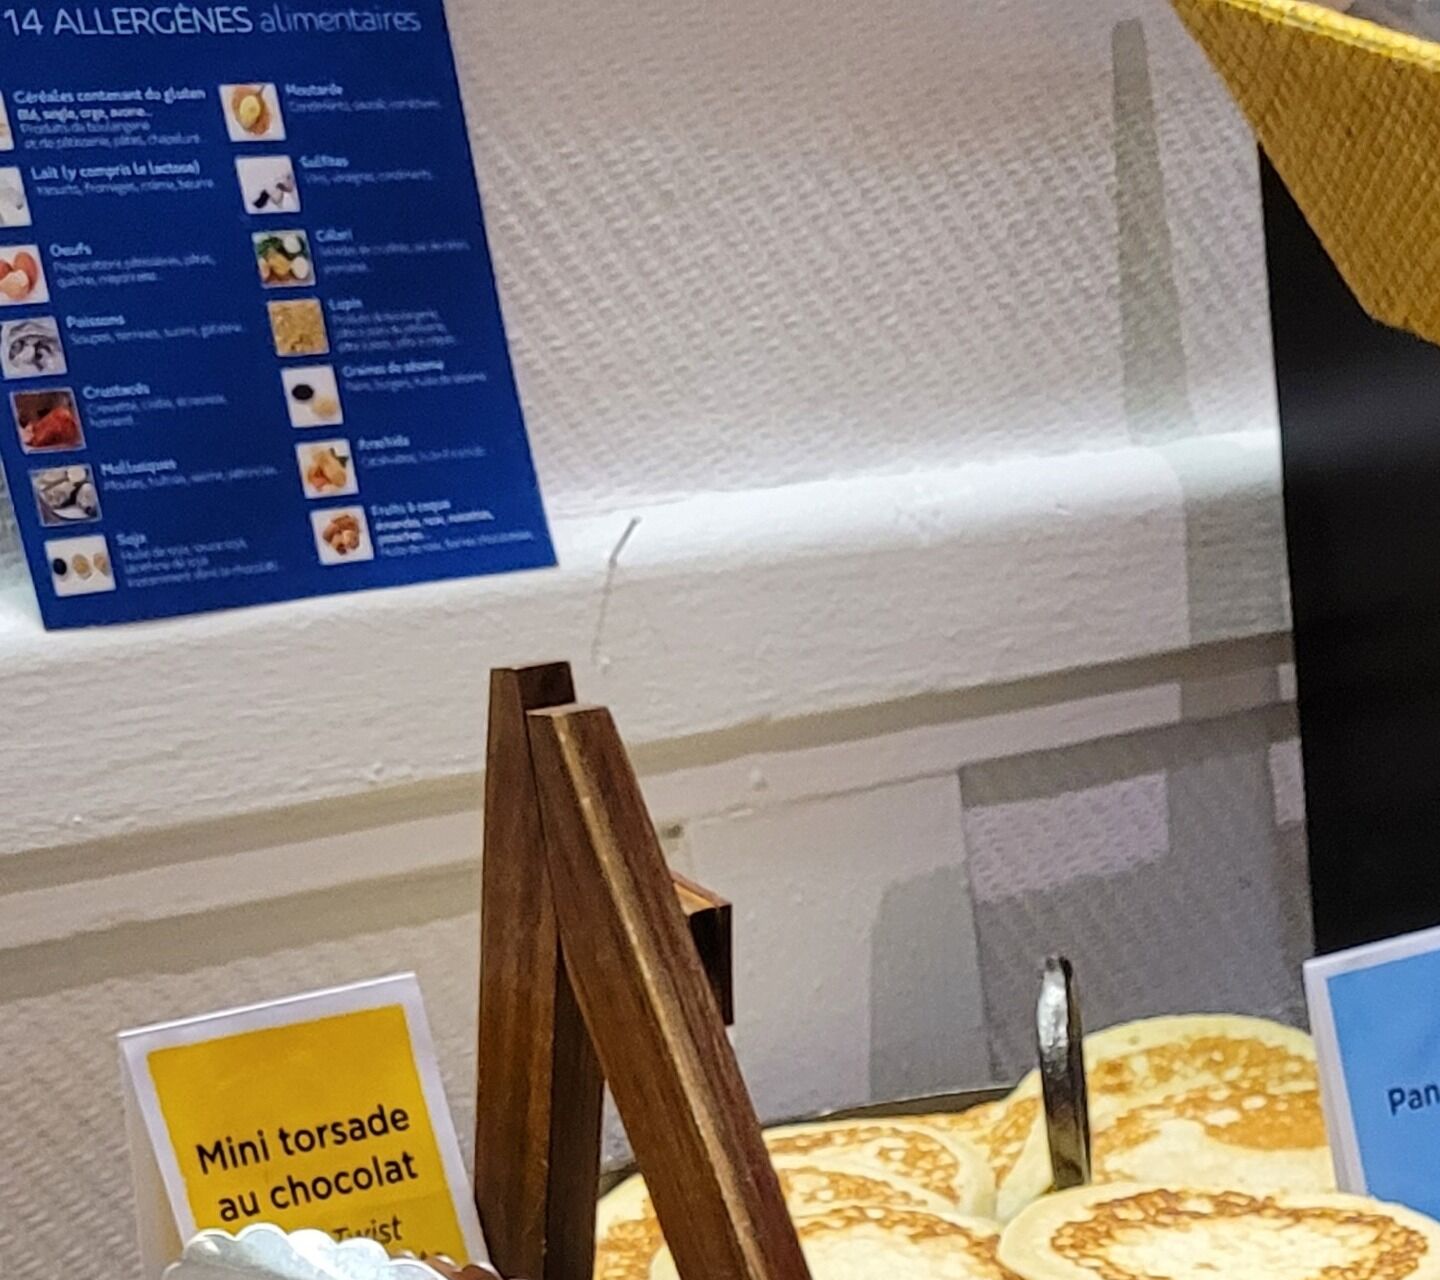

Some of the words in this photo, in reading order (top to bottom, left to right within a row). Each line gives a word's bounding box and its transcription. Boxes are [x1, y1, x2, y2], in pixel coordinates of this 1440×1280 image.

[3, 8, 43, 35] 14
[54, 2, 253, 35] ALLERGÈNES
[260, 5, 421, 33] alimentaires
[65, 315, 125, 328] Poissons
[82, 382, 150, 400] Crustacés
[196, 1129, 271, 1176] Mini
[278, 1104, 411, 1157] torsade
[218, 1191, 261, 1223] au
[270, 1150, 419, 1210] chocolat
